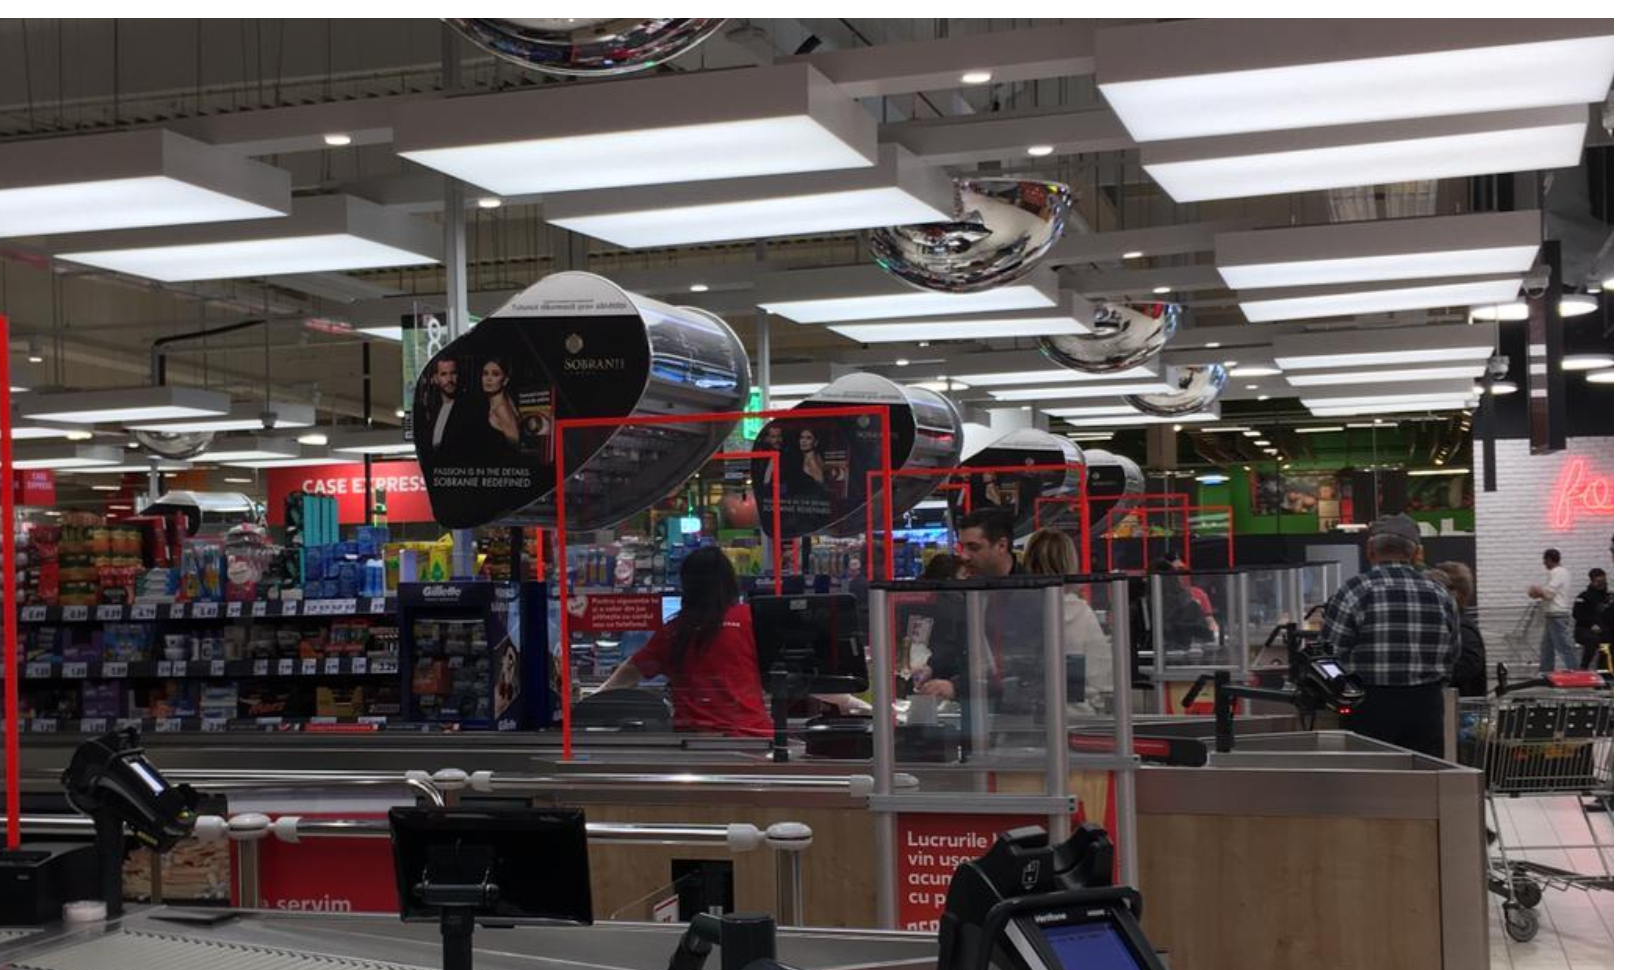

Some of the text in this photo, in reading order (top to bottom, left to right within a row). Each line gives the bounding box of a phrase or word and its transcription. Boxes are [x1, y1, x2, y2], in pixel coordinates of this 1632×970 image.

[302, 478, 347, 494] CASE
[422, 585, 462, 598] Gillette
[907, 830, 988, 848] Lucrurile
[907, 850, 934, 866] vin
[276, 893, 352, 912] servim
[908, 892, 929, 904] cu
